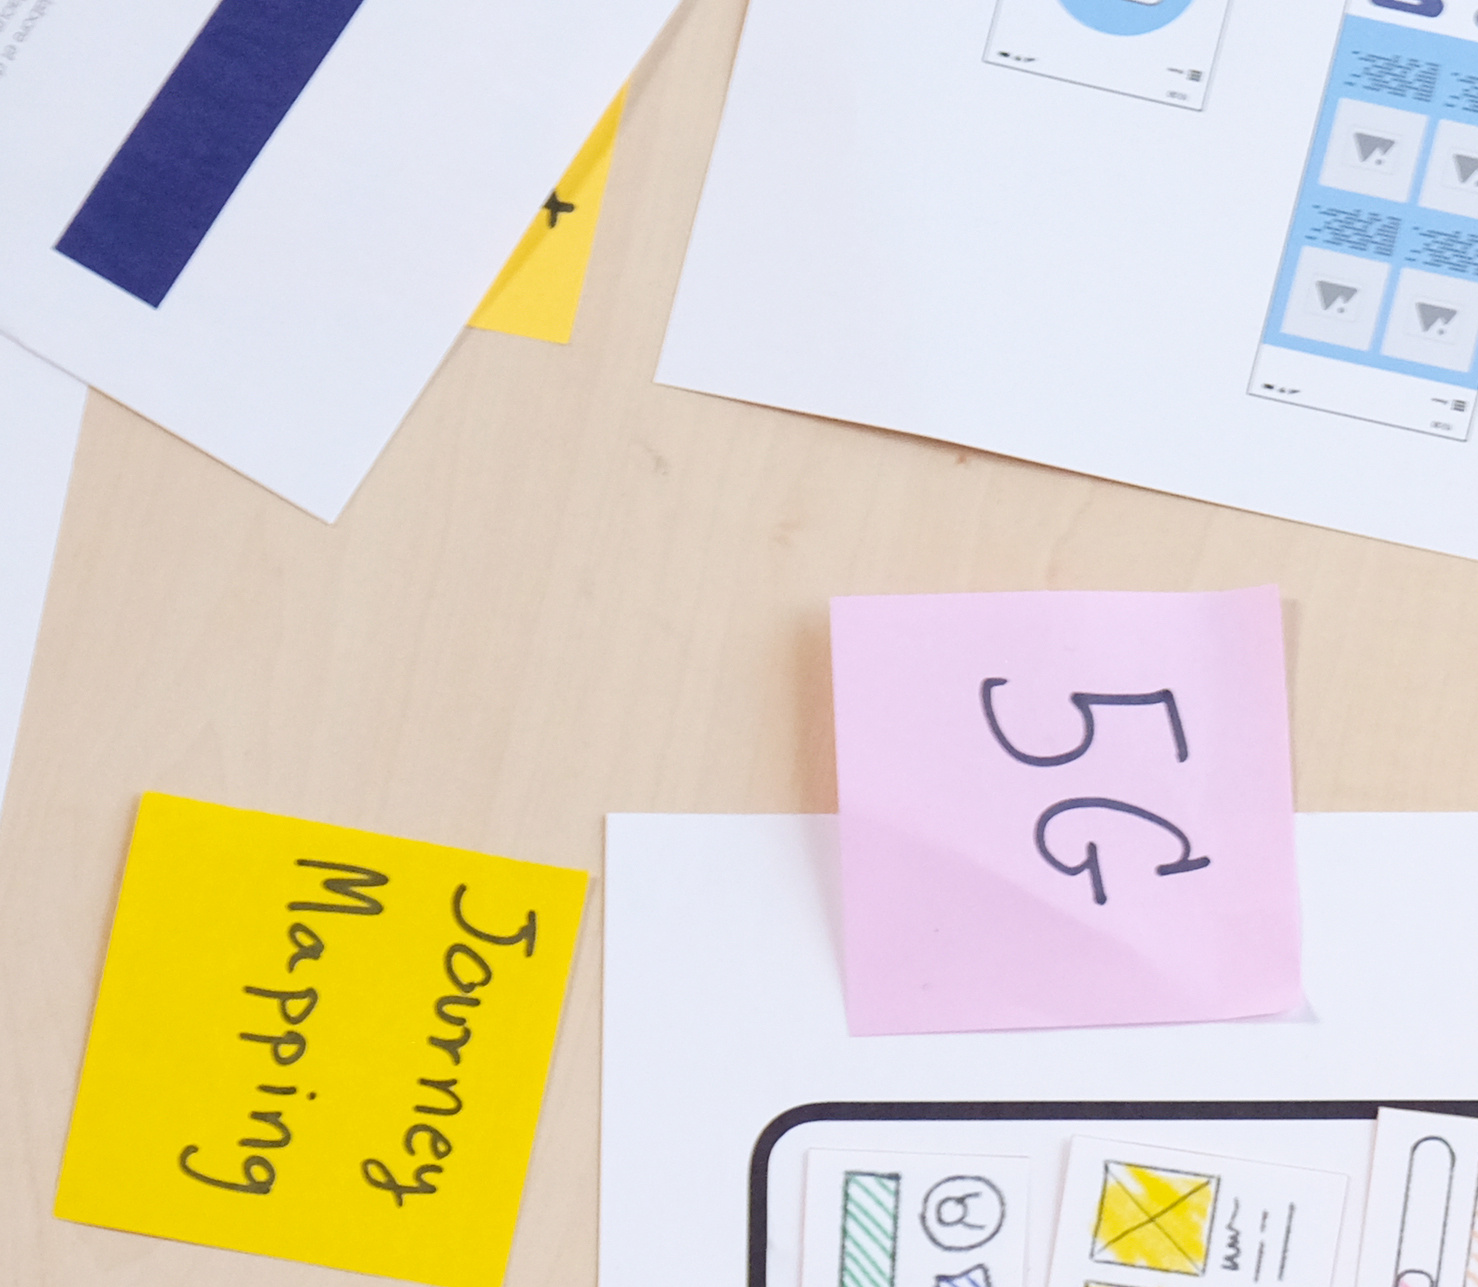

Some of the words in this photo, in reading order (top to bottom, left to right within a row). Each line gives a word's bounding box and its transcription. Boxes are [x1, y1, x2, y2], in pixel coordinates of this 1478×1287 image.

[980, 676, 1211, 907] 5G
[177, 857, 391, 1197] Mapping
[362, 883, 539, 1208] Journey
